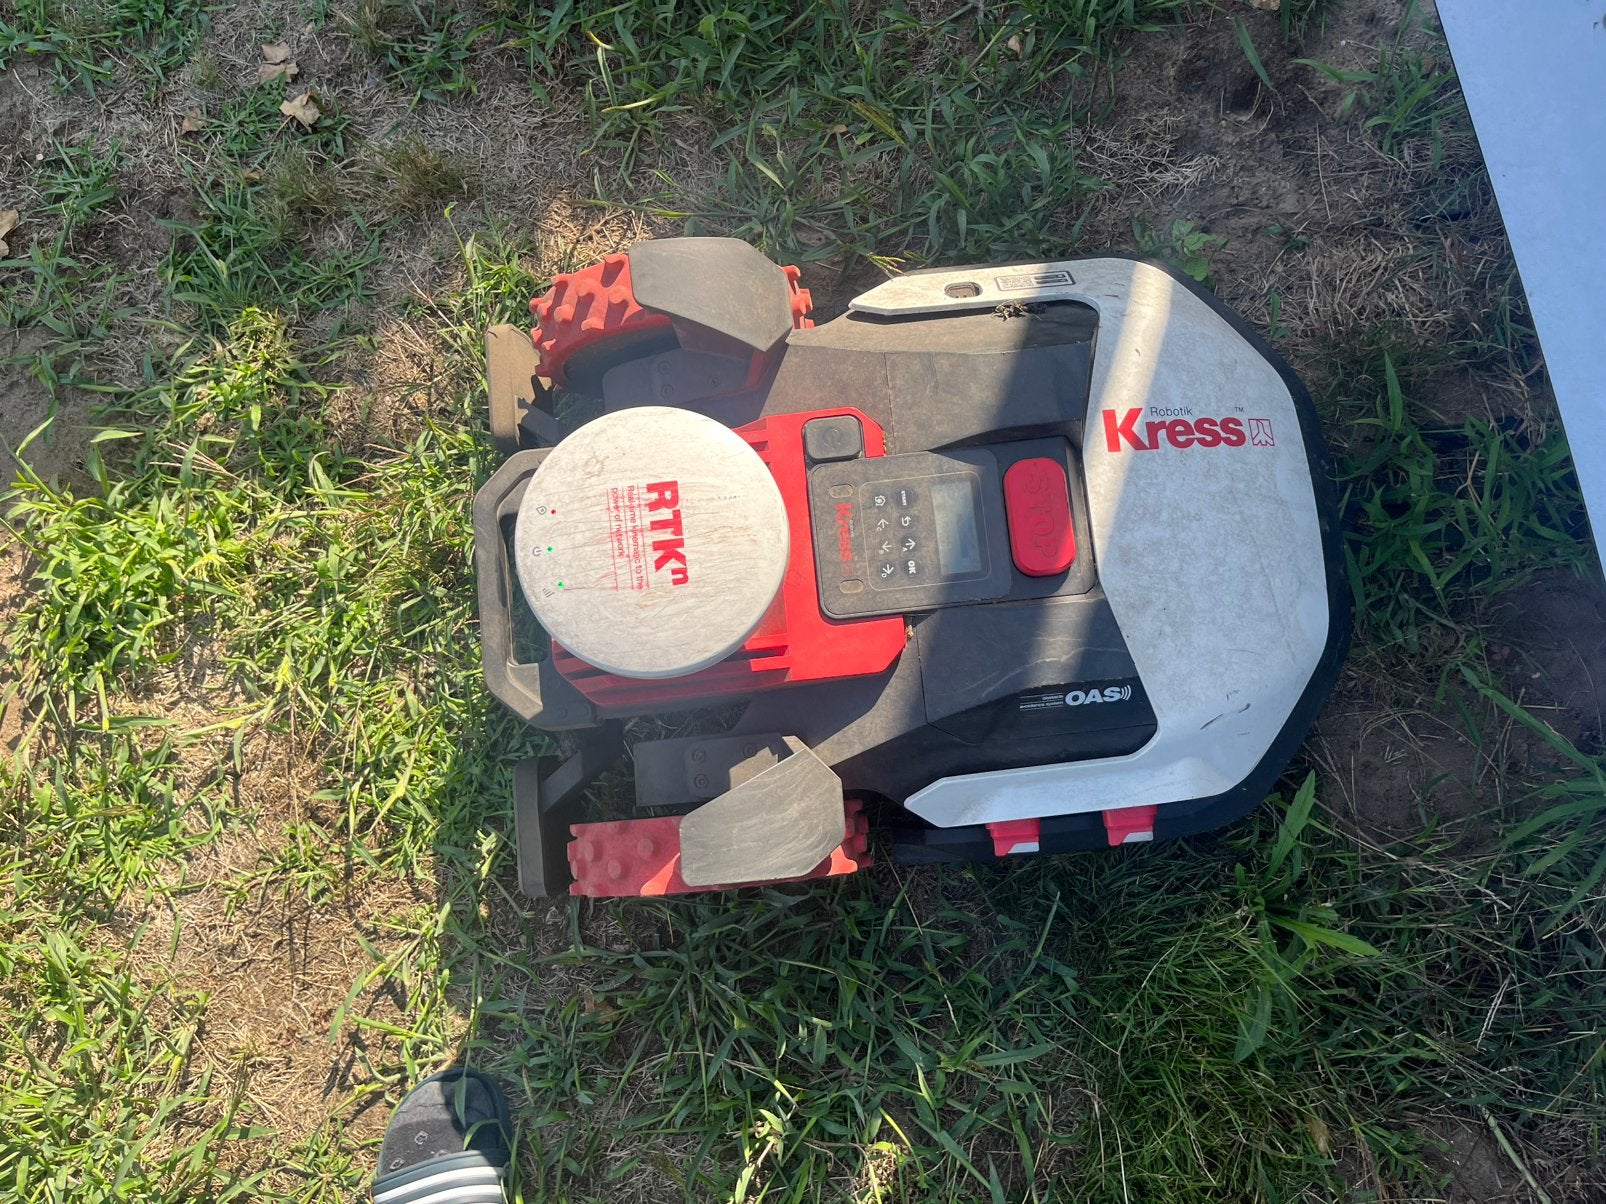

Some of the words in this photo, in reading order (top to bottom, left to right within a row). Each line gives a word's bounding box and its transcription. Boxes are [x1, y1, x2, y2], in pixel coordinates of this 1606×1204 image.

[1150, 406, 1193, 417] Robotik
[1102, 407, 1247, 453] Kress
[611, 487, 620, 513] power
[614, 514, 623, 523] of
[1025, 471, 1058, 557] STOP
[616, 524, 626, 558] network
[835, 503, 853, 561] Kress
[631, 525, 641, 564] kinematic
[635, 565, 643, 575] to
[907, 560, 916, 574] OK
[636, 575, 645, 590] the
[1064, 686, 1121, 706] OAS
